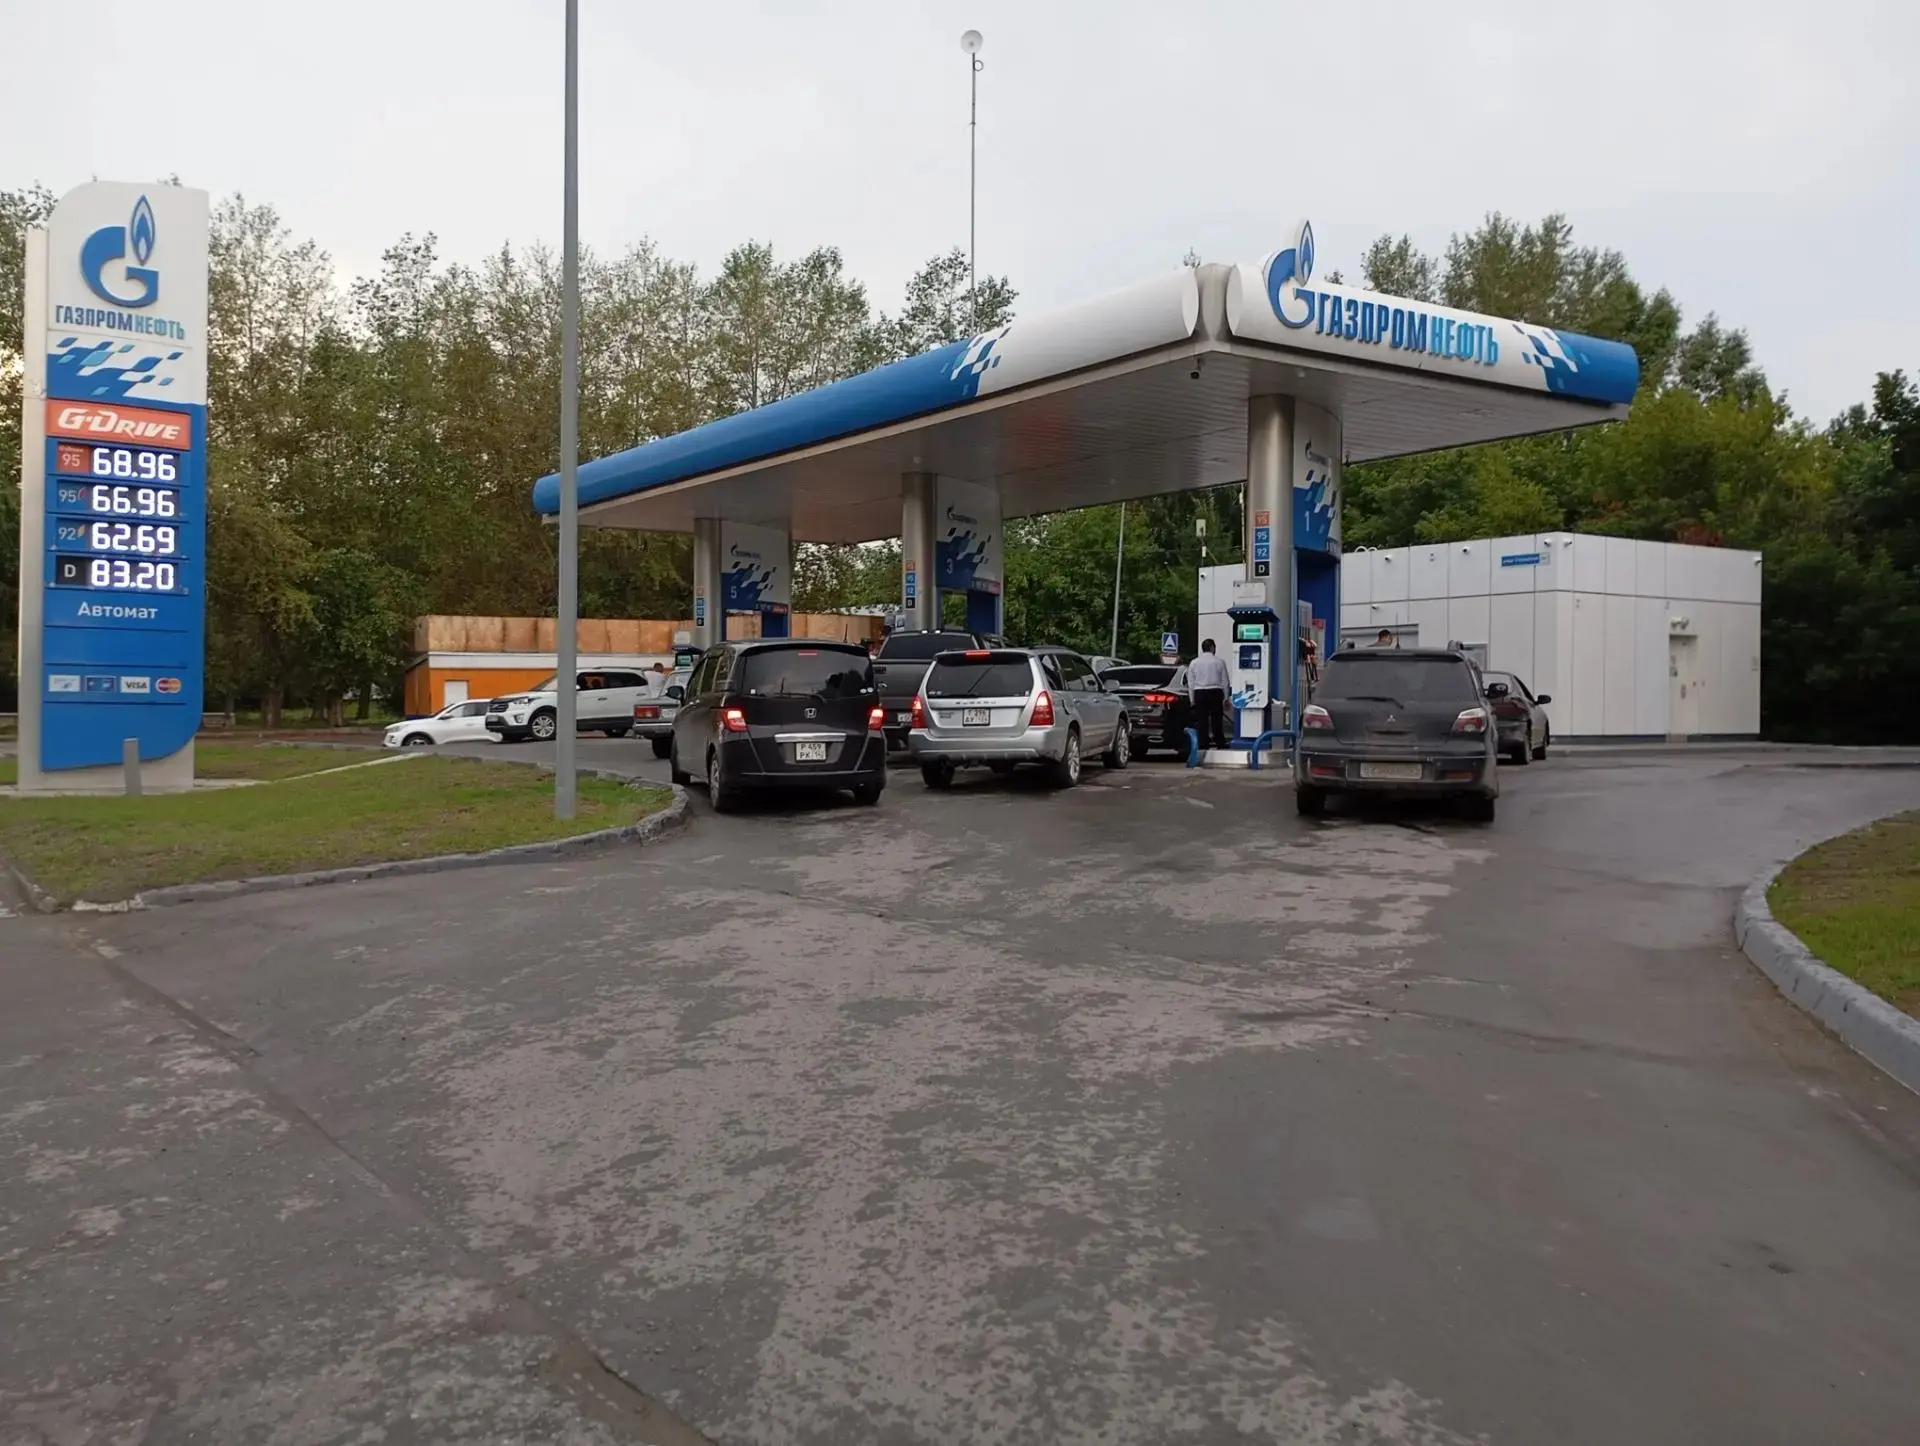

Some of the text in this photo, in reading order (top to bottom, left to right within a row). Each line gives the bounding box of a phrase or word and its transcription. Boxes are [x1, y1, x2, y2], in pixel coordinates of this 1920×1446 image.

[55, 304, 186, 340] ГАЗПРОМНЕФТЬ
[1315, 292, 1500, 367] ГАЗПРОМНЕФТЬ
[62, 448, 176, 481] 95 68.96
[58, 485, 175, 517] 95 66.96
[58, 522, 175, 554] 92 62.69
[1256, 531, 1268, 541] 95
[1256, 547, 1268, 557] 92
[63, 559, 175, 590] D 83.20
[1258, 564, 1266, 574] D
[77, 601, 159, 619] Автомат
[125, 680, 148, 690] VISA
